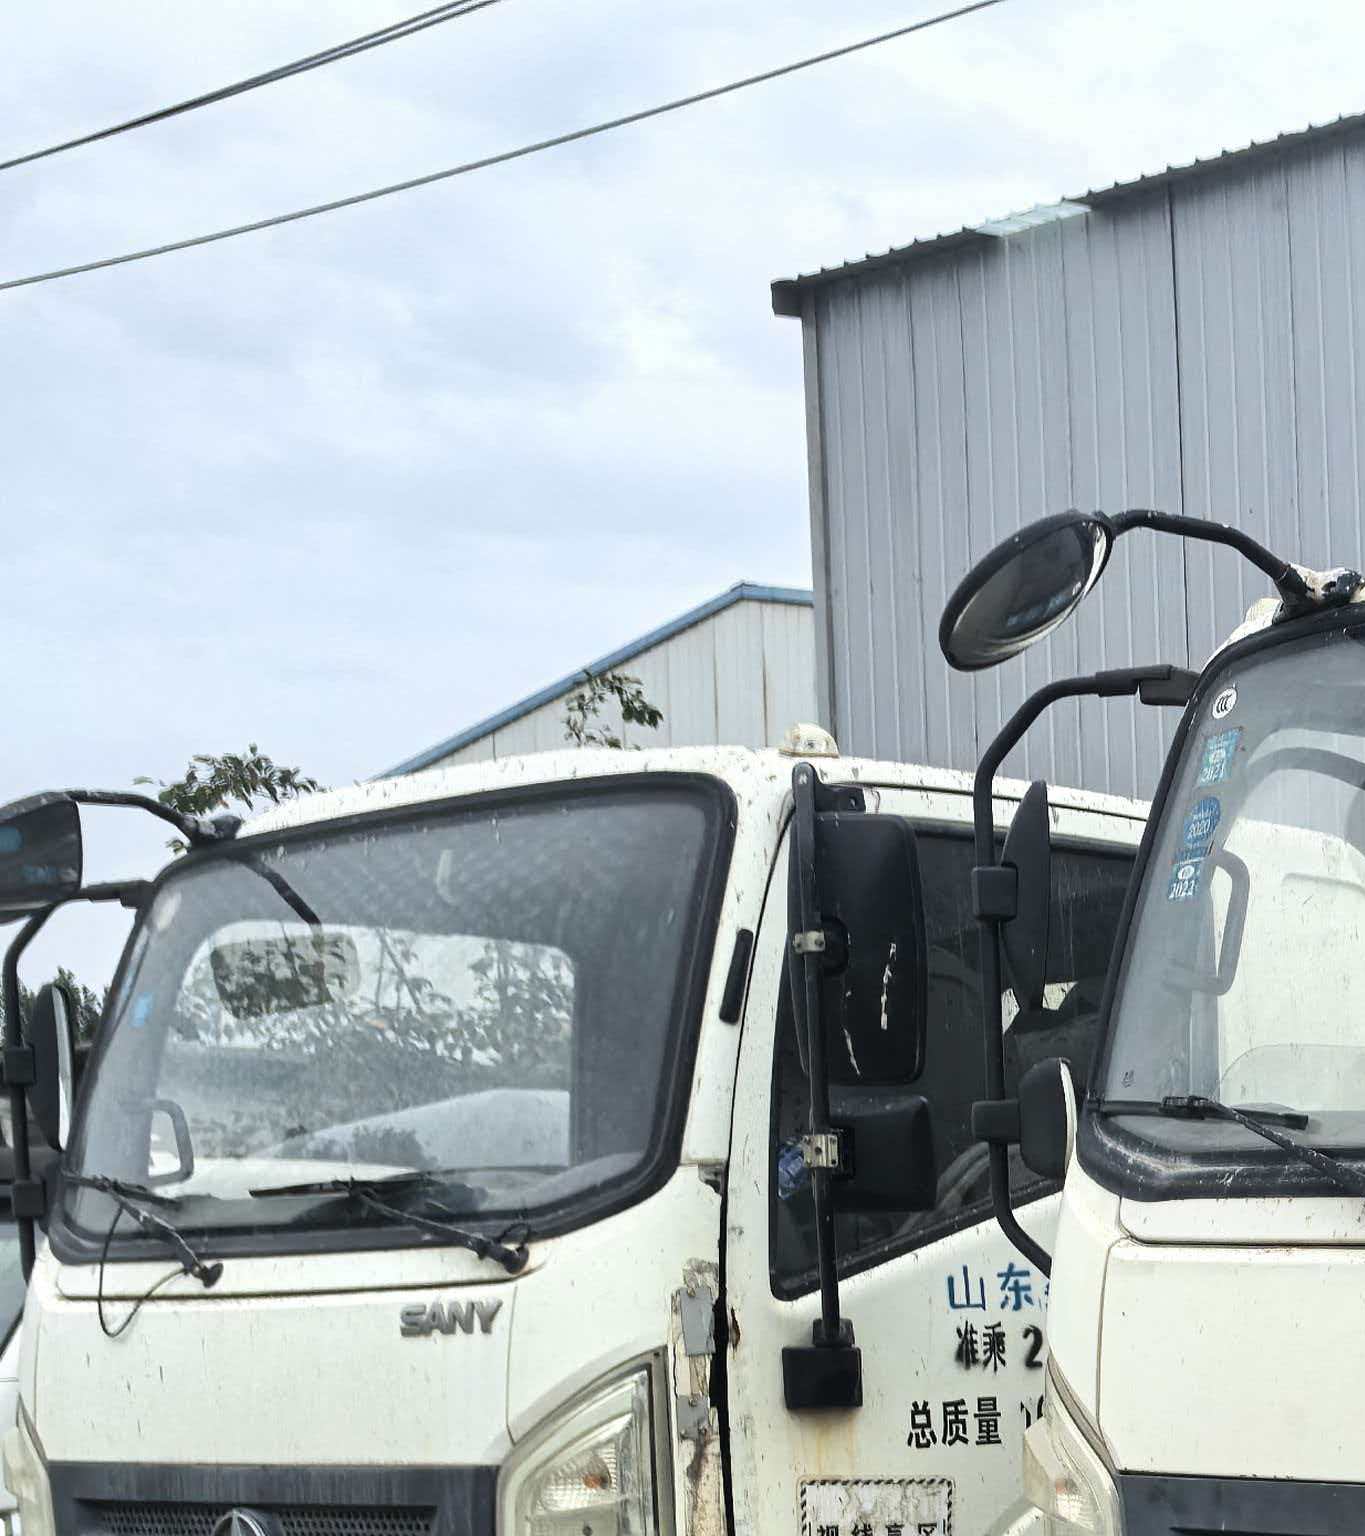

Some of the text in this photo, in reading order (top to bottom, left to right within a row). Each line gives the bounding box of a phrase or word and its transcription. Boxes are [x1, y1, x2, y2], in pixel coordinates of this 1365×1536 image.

[947, 1262, 1050, 1312] 山东
[400, 1297, 503, 1337] SANY
[907, 1396, 1003, 1449] 总质量
